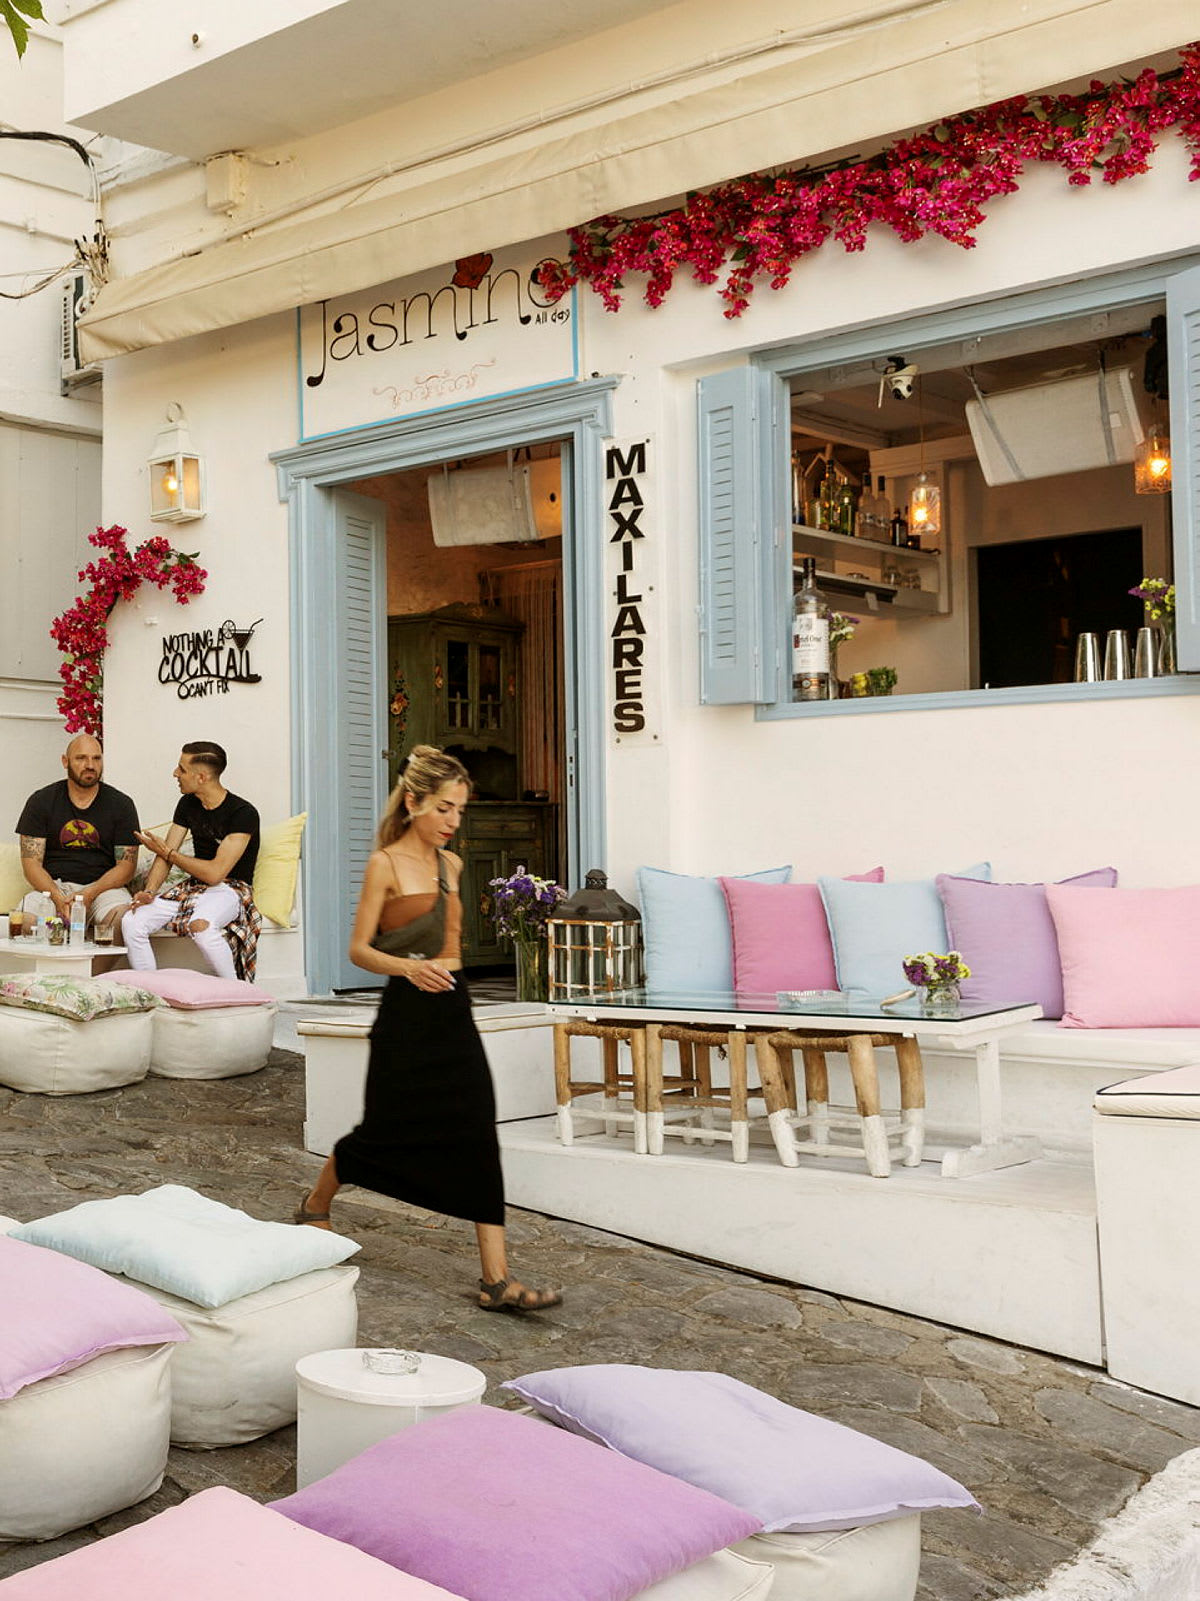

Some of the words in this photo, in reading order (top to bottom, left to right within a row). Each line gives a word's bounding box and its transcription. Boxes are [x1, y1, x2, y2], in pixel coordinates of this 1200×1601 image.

[535, 312, 548, 325] All
[551, 308, 570, 325] day
[605, 442, 647, 733] MAXILARES
[162, 629, 213, 656] NOTHING
[216, 627, 225, 647] A
[158, 646, 262, 684] COCKTAIL
[217, 679, 230, 694] FIX
